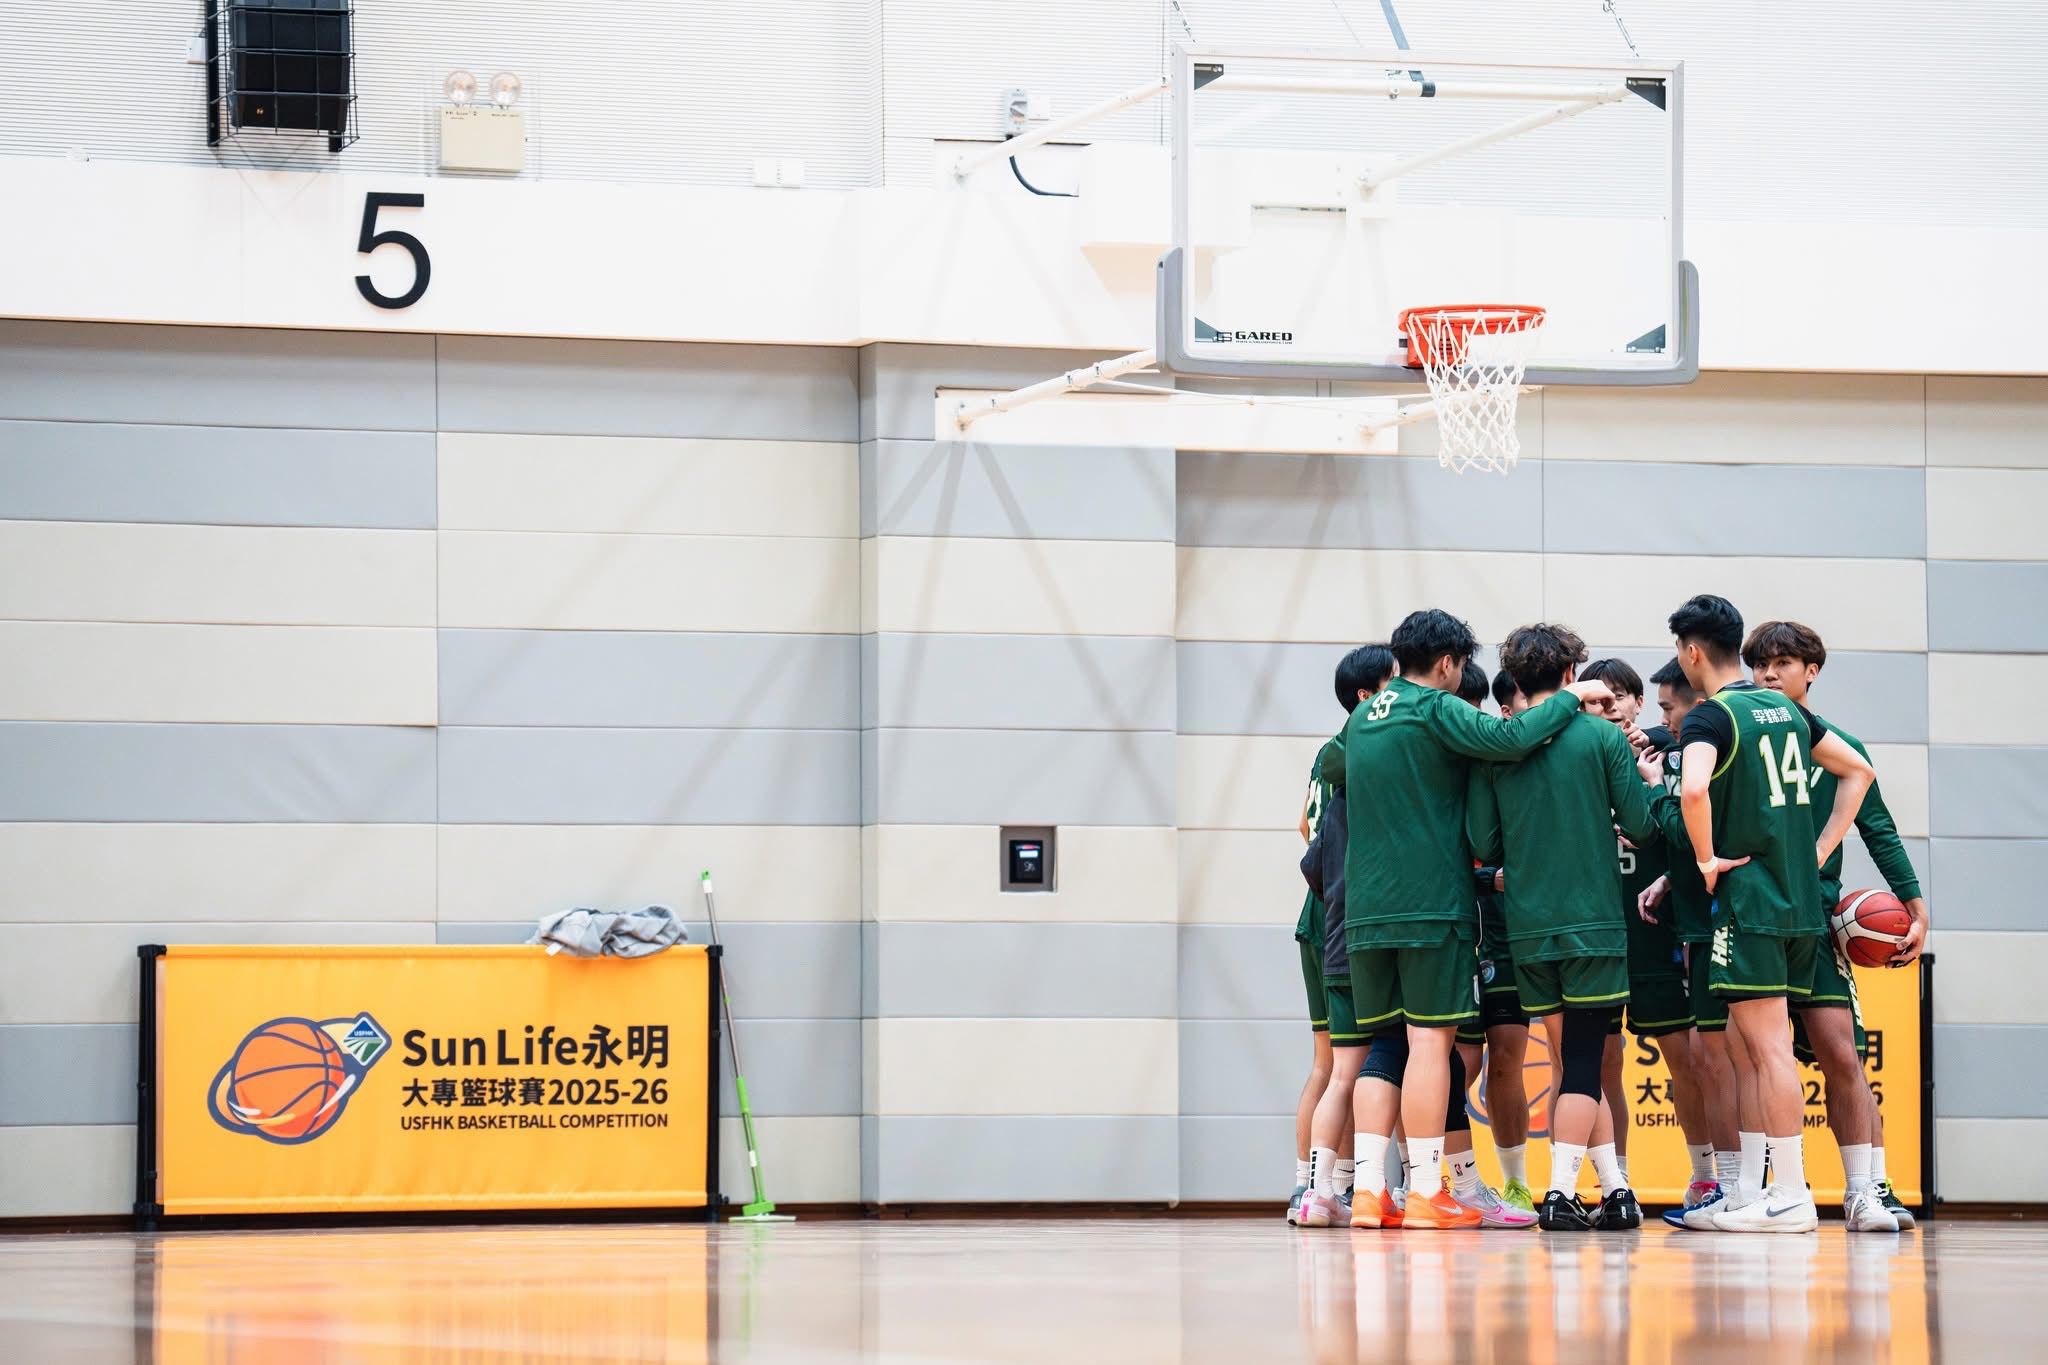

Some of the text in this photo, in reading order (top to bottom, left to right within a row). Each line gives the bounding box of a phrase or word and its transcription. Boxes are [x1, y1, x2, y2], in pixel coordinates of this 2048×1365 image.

[354, 191, 431, 309] 5
[1235, 331, 1293, 341] GARED
[1758, 731, 1811, 808] 14
[1711, 926, 1729, 967] HK
[402, 1029, 487, 1067] Sun
[400, 1113, 668, 1130] USFHK BASKETBALL COMPETITION
